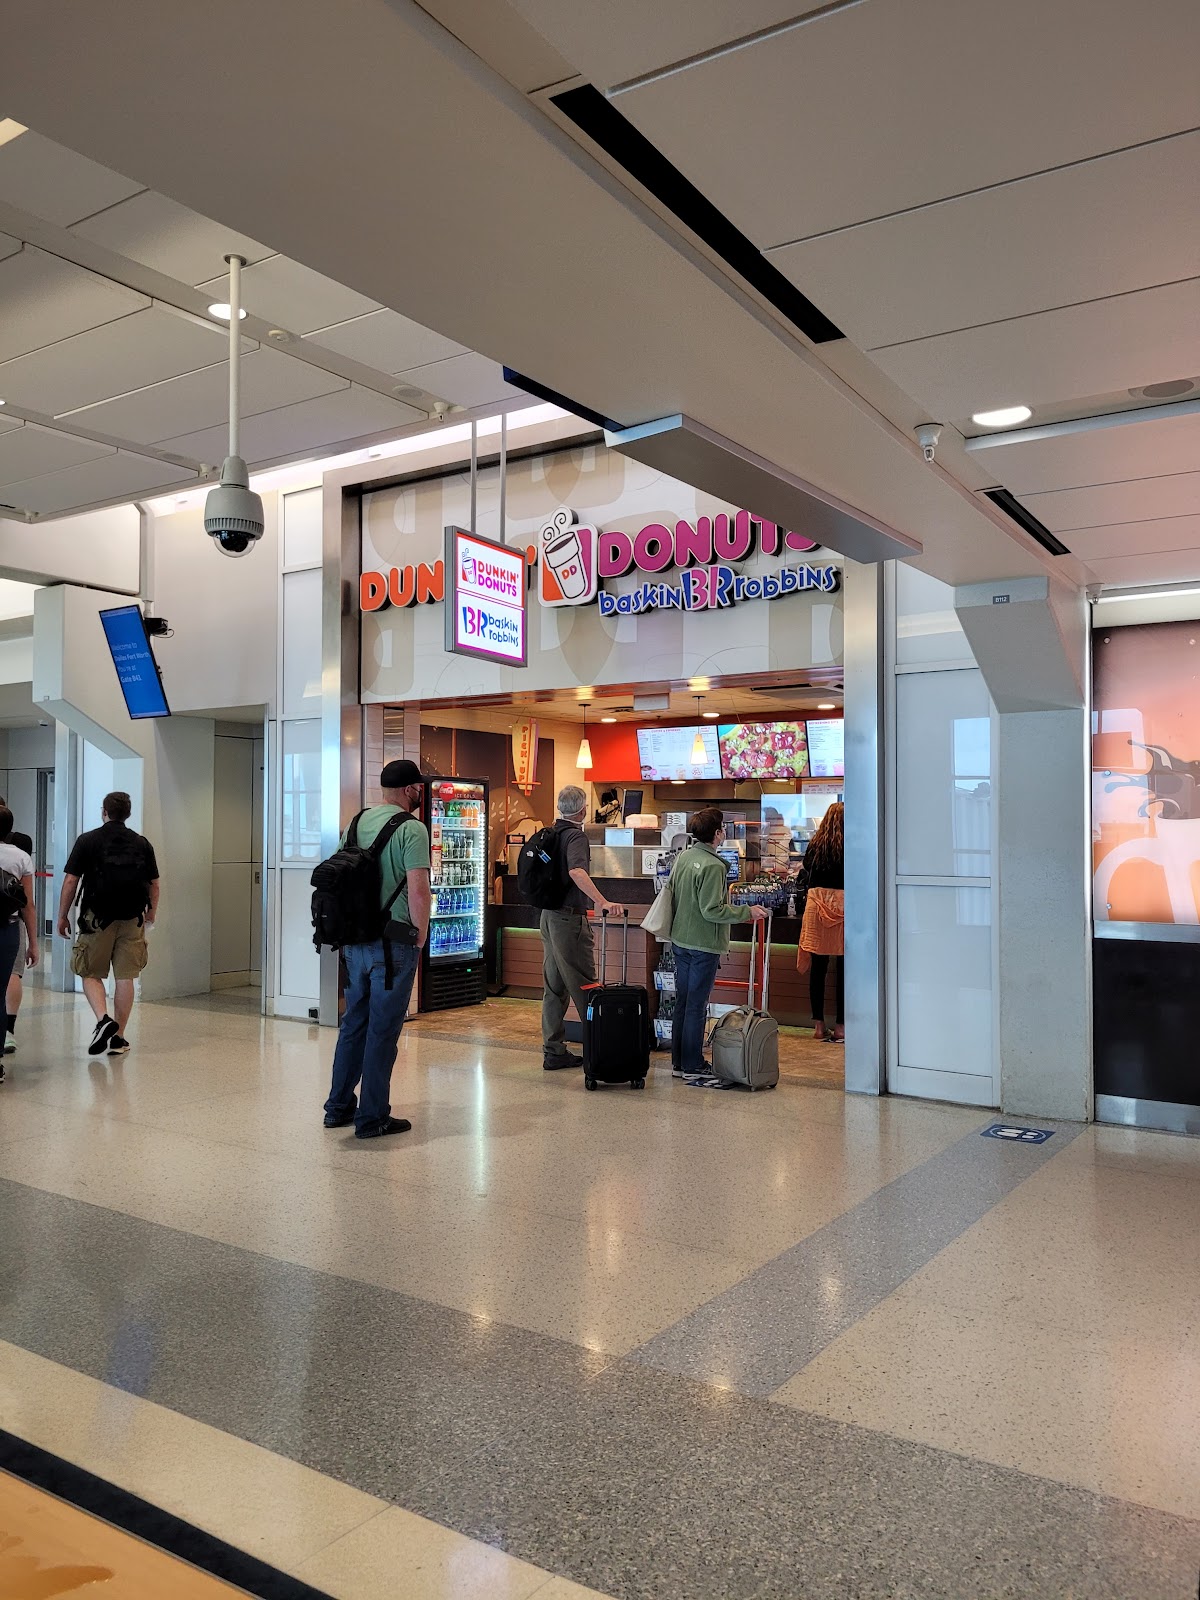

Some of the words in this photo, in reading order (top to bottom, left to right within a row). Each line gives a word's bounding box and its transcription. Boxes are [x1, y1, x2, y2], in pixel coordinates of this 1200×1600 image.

[478, 561, 519, 584] DUNKIN'
[561, 564, 578, 580] DD
[478, 577, 517, 597] DONUTS
[598, 582, 682, 616] baskin
[680, 565, 735, 610] BR
[733, 563, 837, 600] robbins
[462, 606, 489, 638] BR
[488, 613, 518, 633] baskin
[489, 629, 519, 647] robbins
